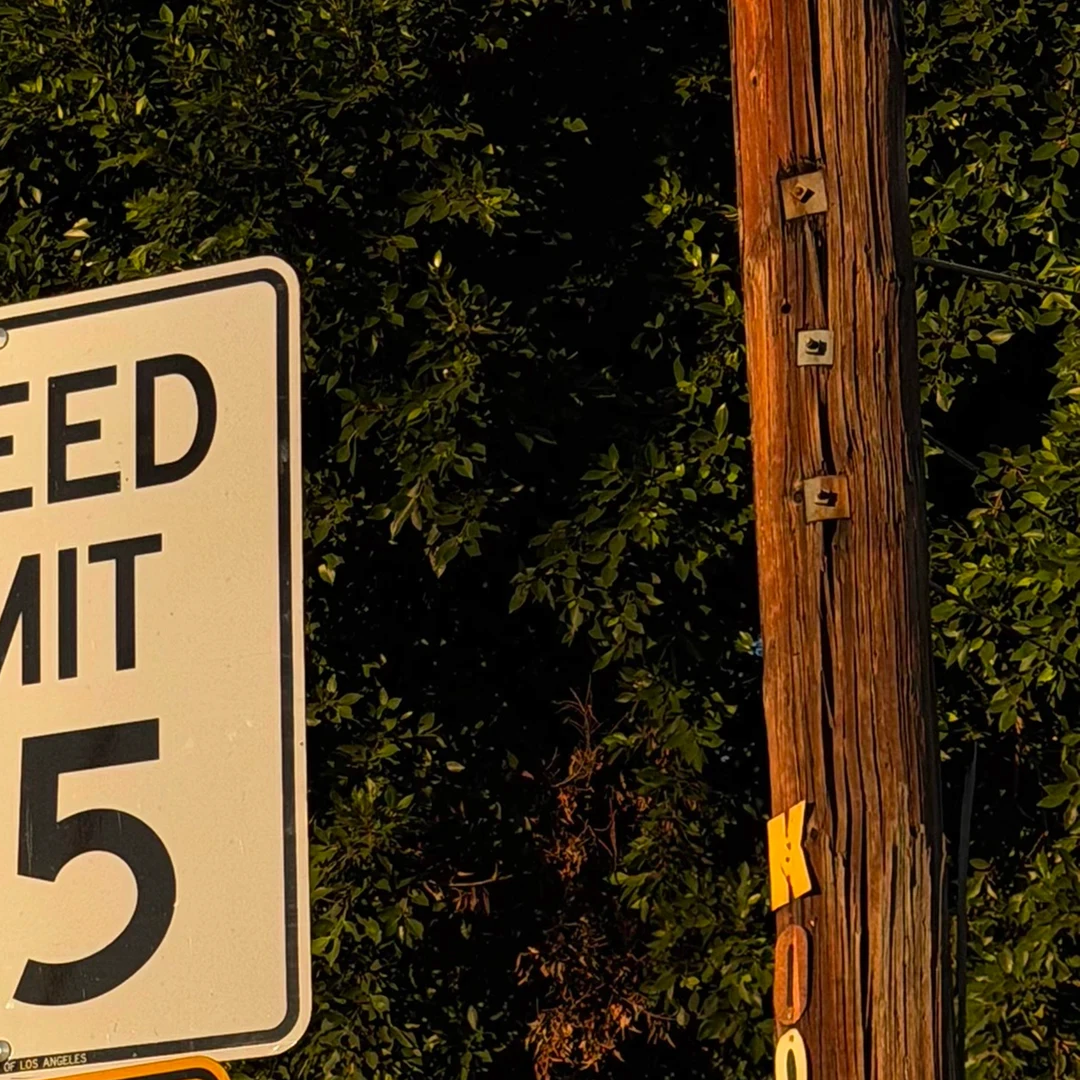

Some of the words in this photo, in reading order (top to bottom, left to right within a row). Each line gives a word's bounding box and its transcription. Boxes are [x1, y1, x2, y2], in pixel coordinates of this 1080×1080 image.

[3, 1060, 16, 1073] OF
[19, 1057, 39, 1071] LOS
[42, 1053, 87, 1068] ANGELES
